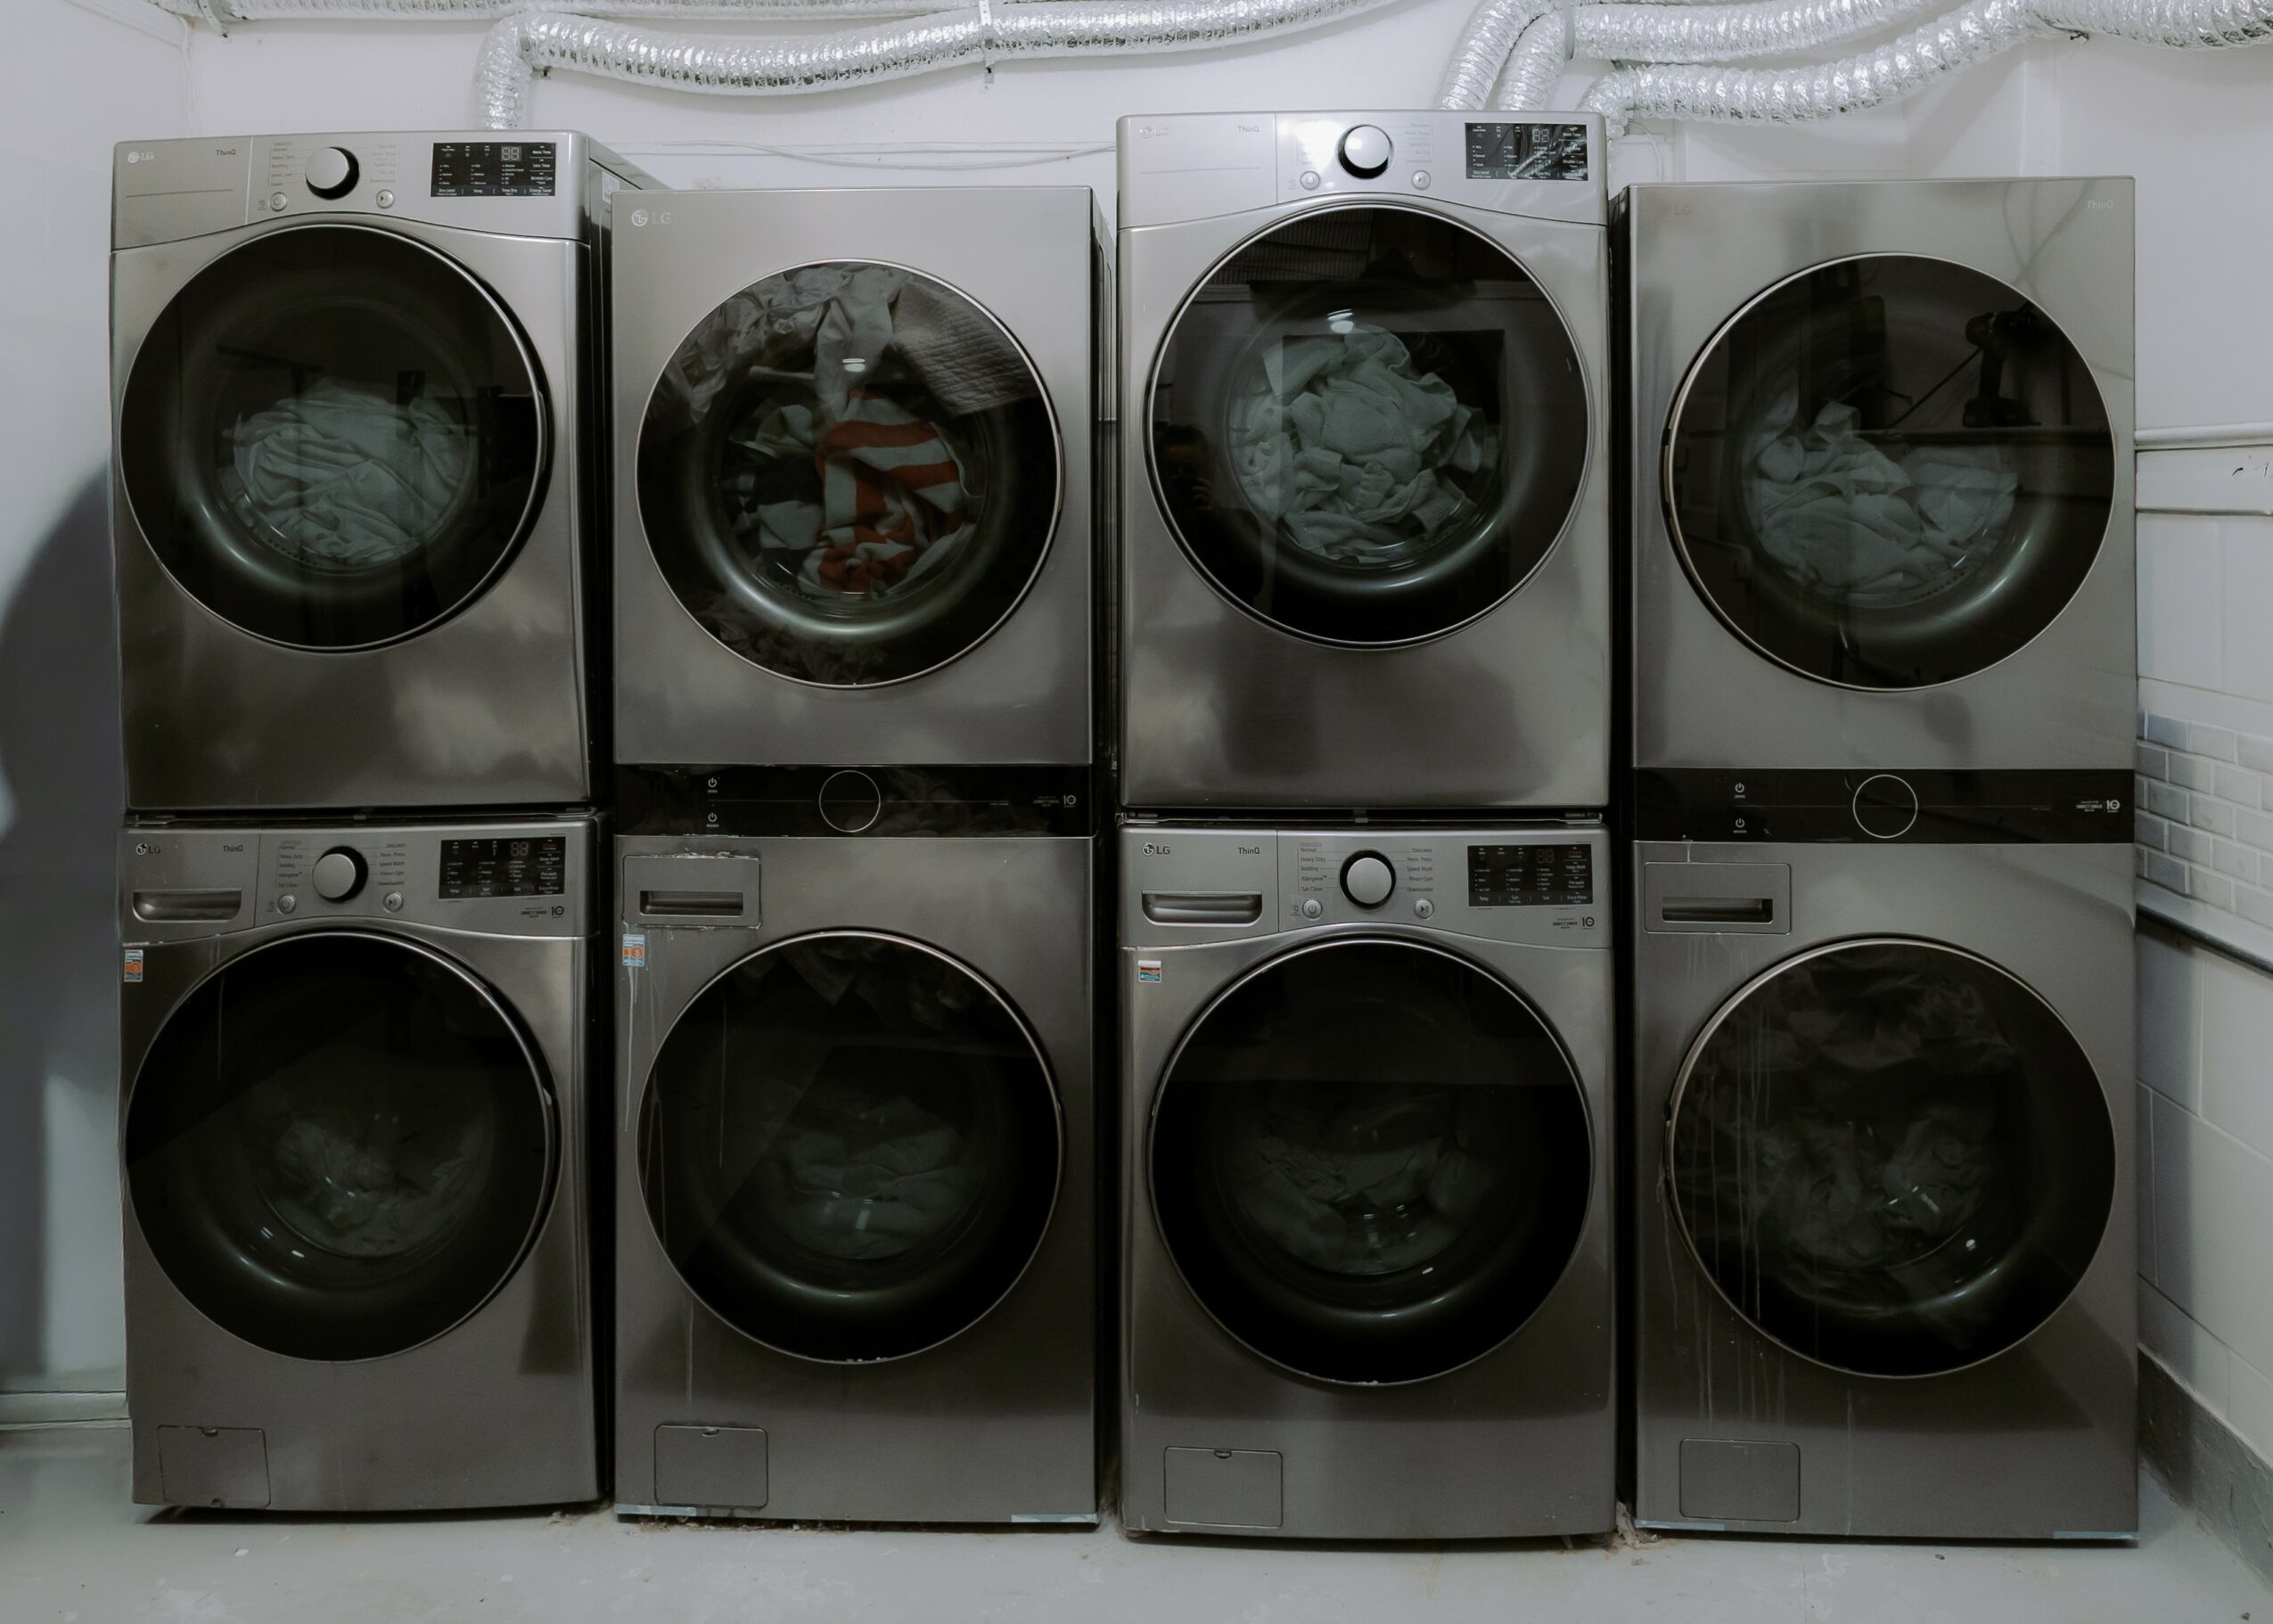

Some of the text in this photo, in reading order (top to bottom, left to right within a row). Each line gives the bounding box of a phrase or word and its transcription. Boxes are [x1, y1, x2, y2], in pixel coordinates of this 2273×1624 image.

[141, 152, 154, 160] LG
[2087, 200, 2113, 209] ThinQ
[148, 846, 160, 854] LG
[223, 844, 242, 852] ThinQ
[1156, 846, 1170, 855] LG
[1238, 847, 1260, 855] ThinQ
